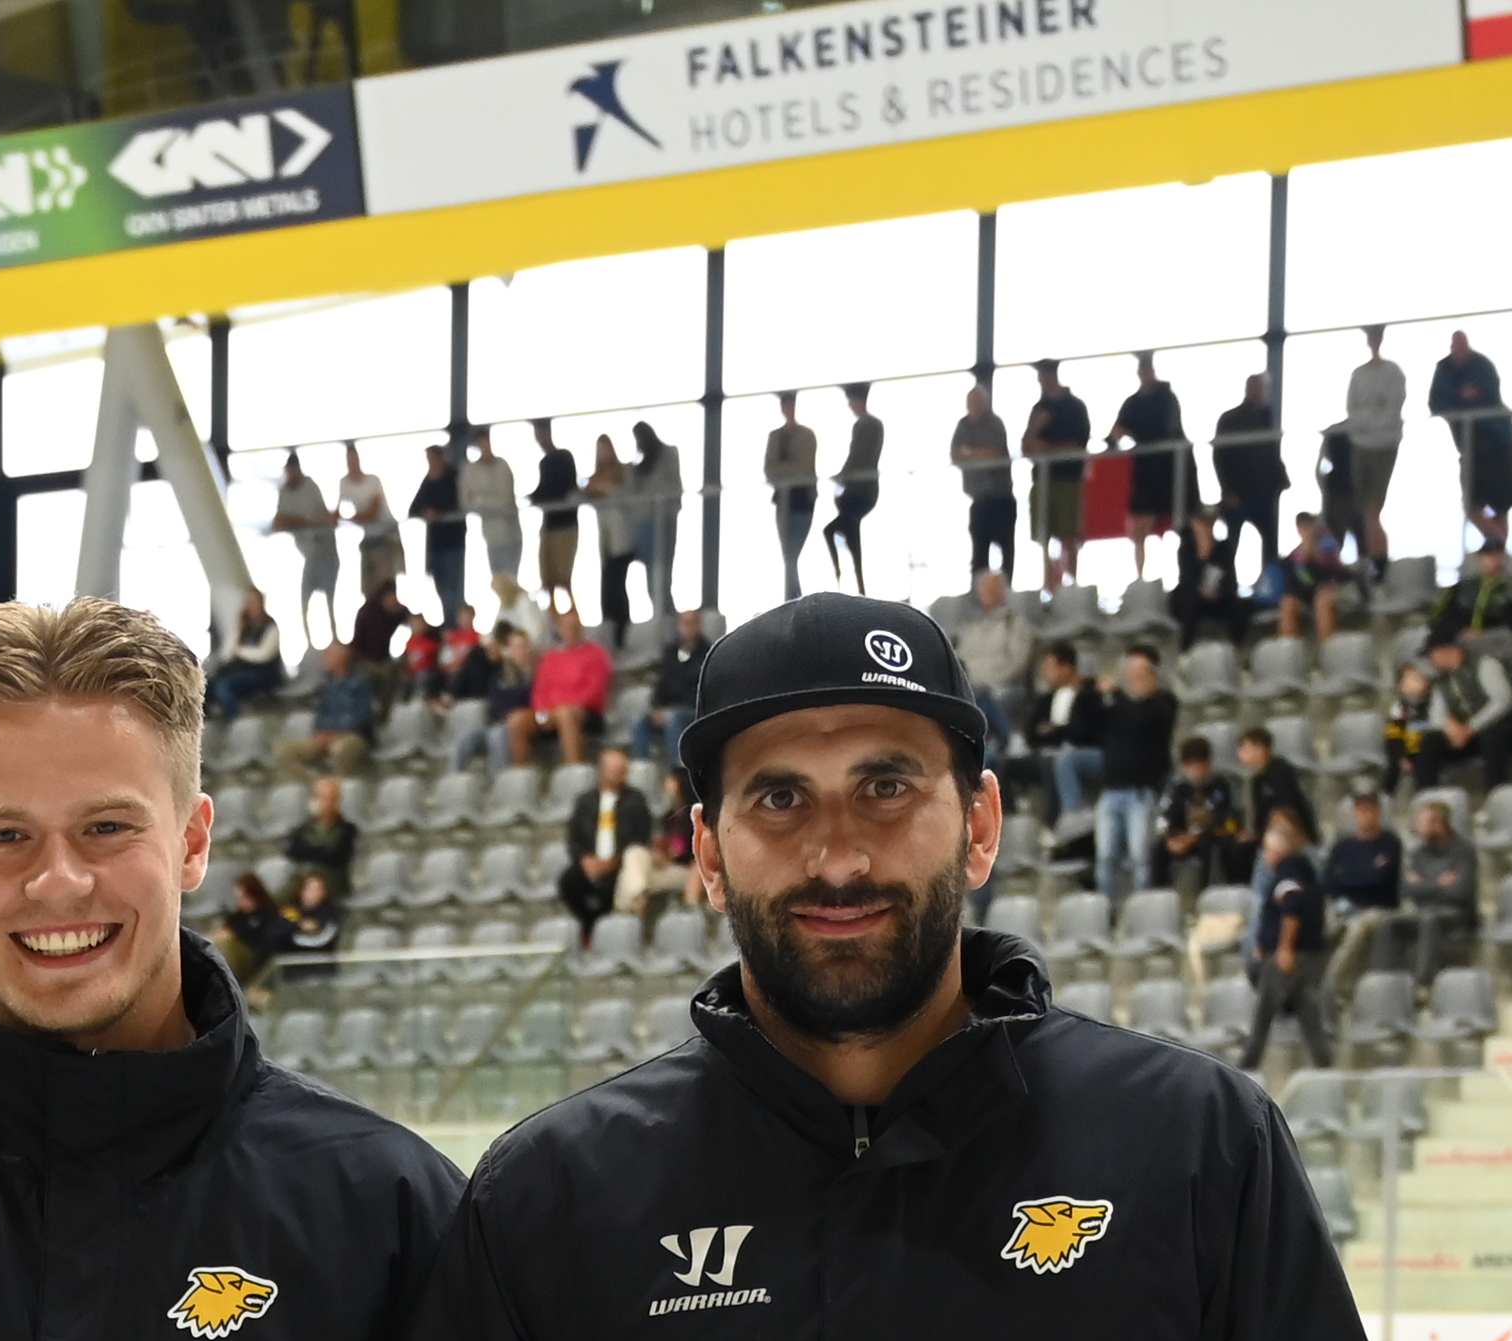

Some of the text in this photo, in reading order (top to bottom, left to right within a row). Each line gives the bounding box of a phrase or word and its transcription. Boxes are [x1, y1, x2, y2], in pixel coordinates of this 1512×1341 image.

[686, 0, 1098, 87] FALKENSTEINER
[689, 37, 1230, 151] HOTELS & RESIDENCES
[648, 1287, 768, 1316] WARRIOR
